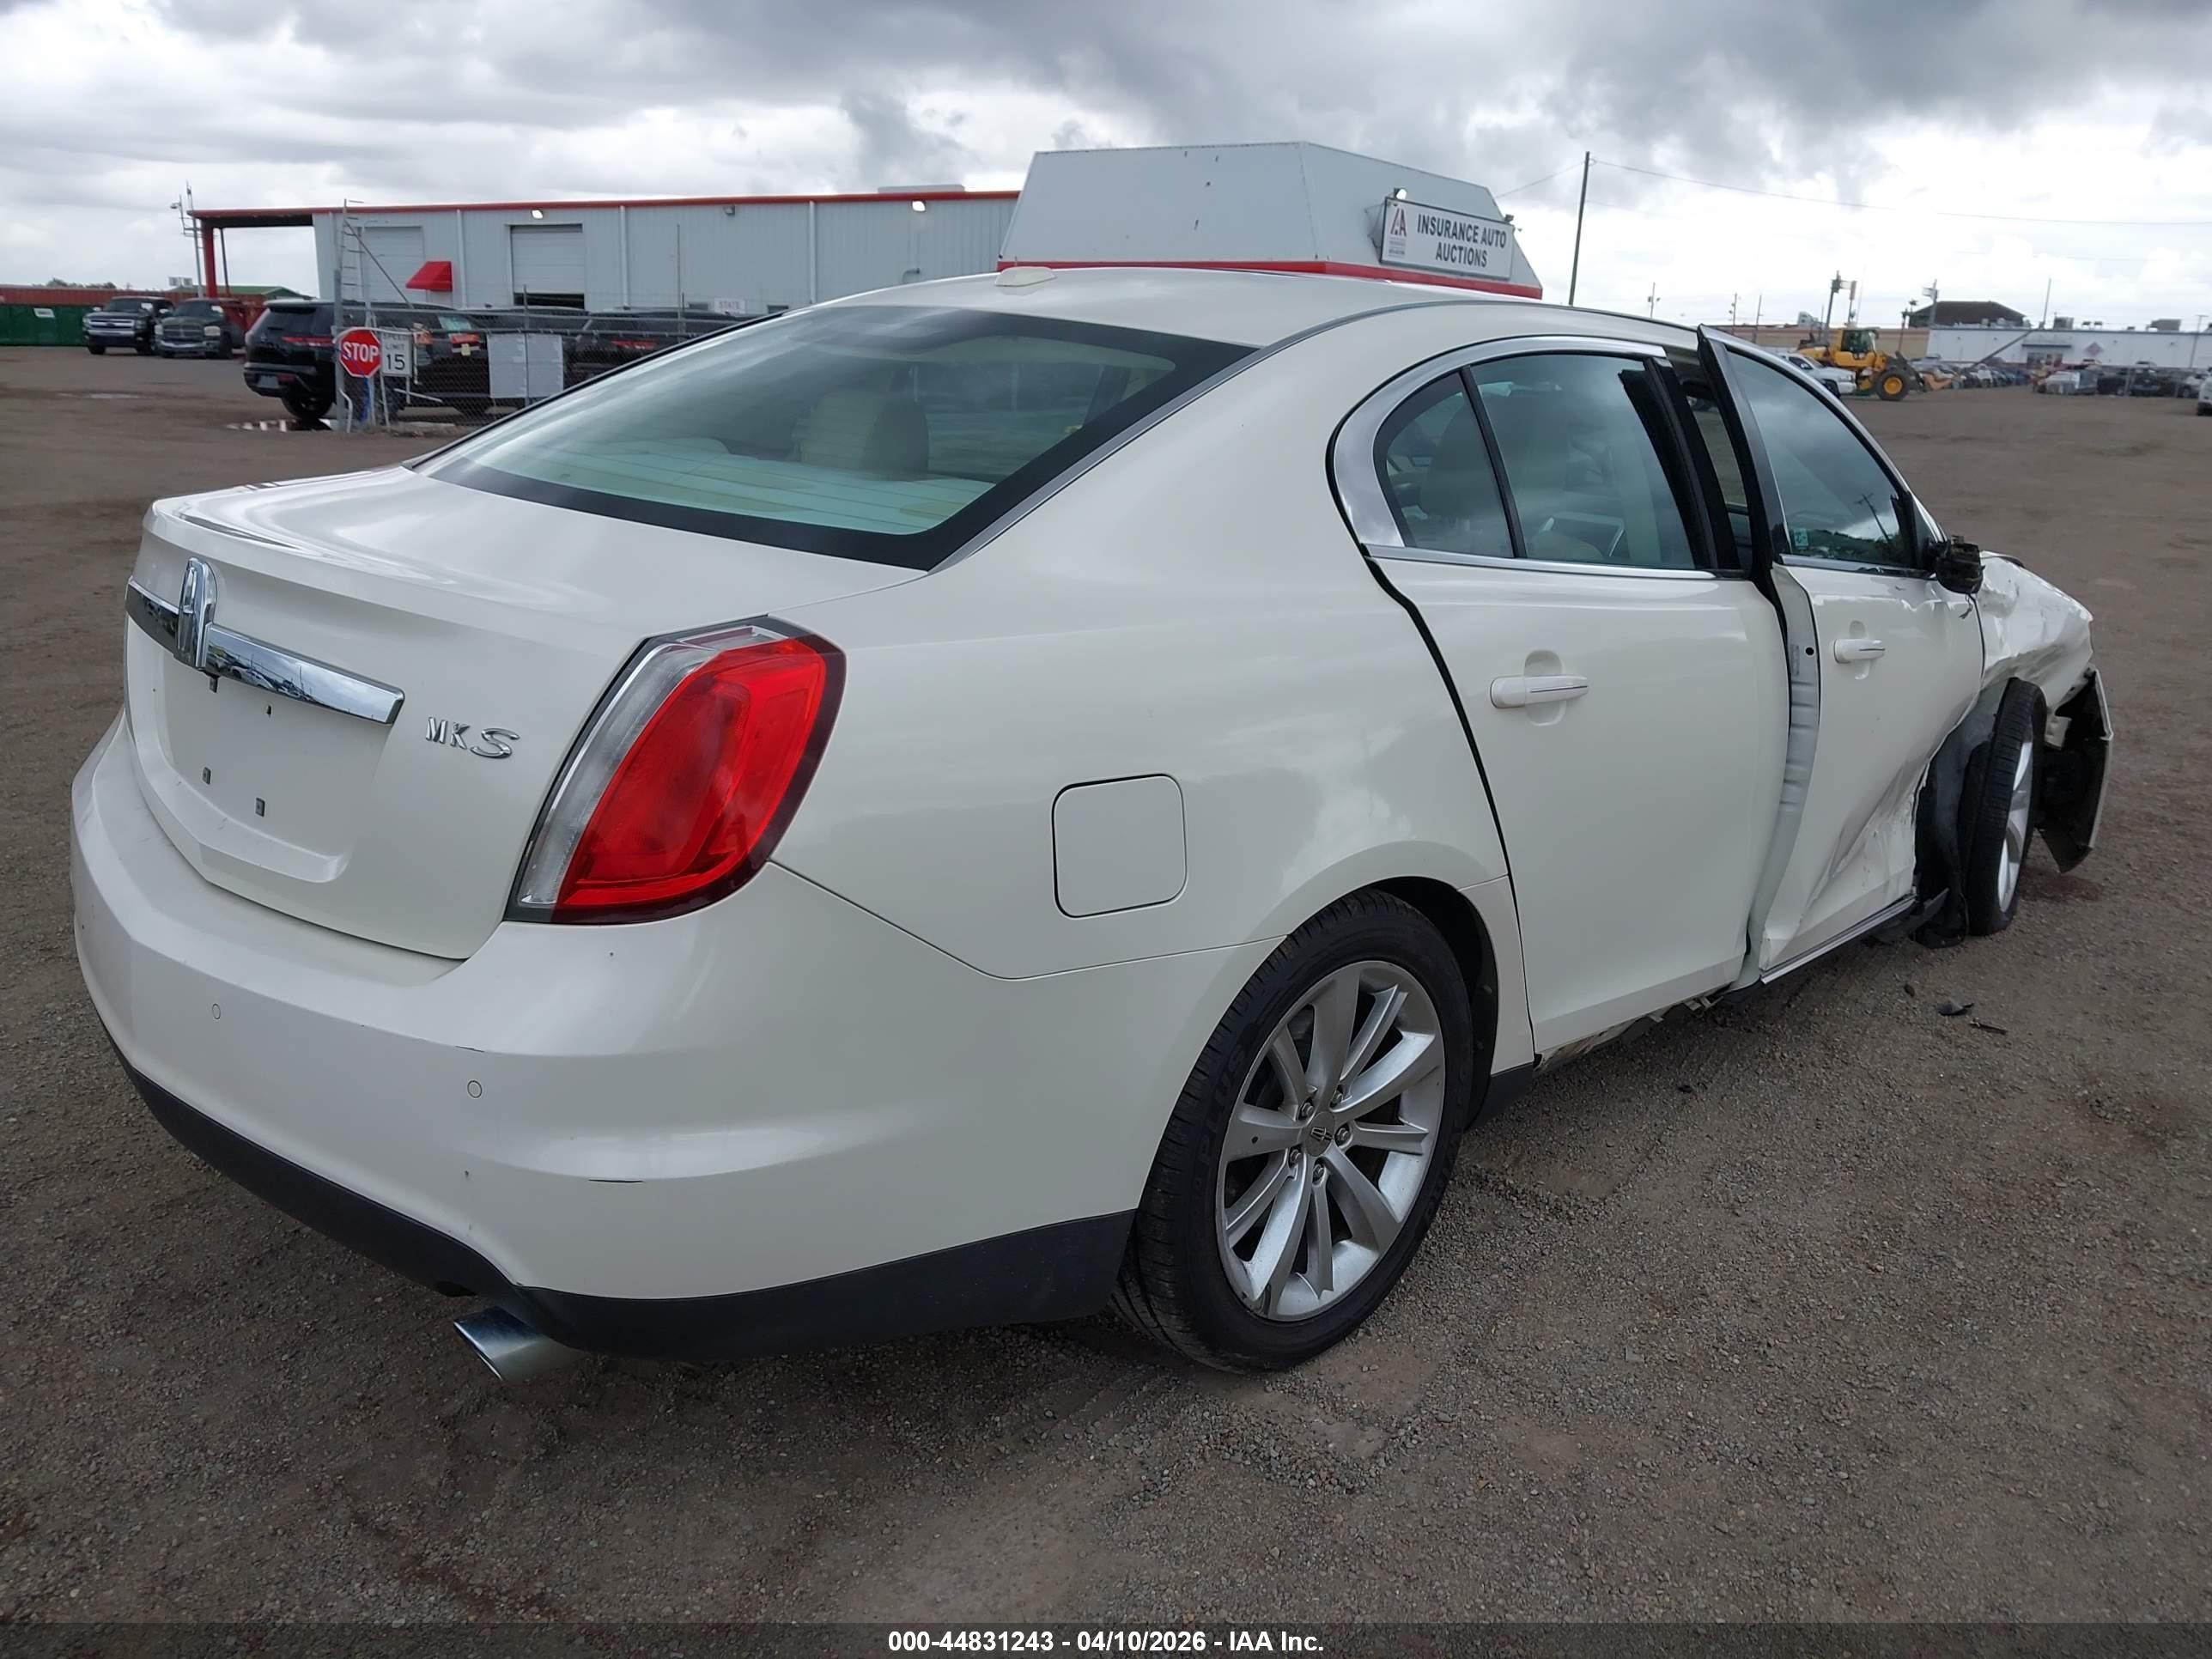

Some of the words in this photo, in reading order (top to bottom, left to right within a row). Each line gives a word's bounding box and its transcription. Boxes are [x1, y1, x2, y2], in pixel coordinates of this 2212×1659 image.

[1417, 213, 1479, 243] INSURANCE
[1480, 226, 1507, 249] AUTO
[1435, 241, 1488, 268] AUCTIONS
[343, 341, 380, 363] STOP
[386, 354, 405, 370] 15
[426, 717, 520, 759] MKS
